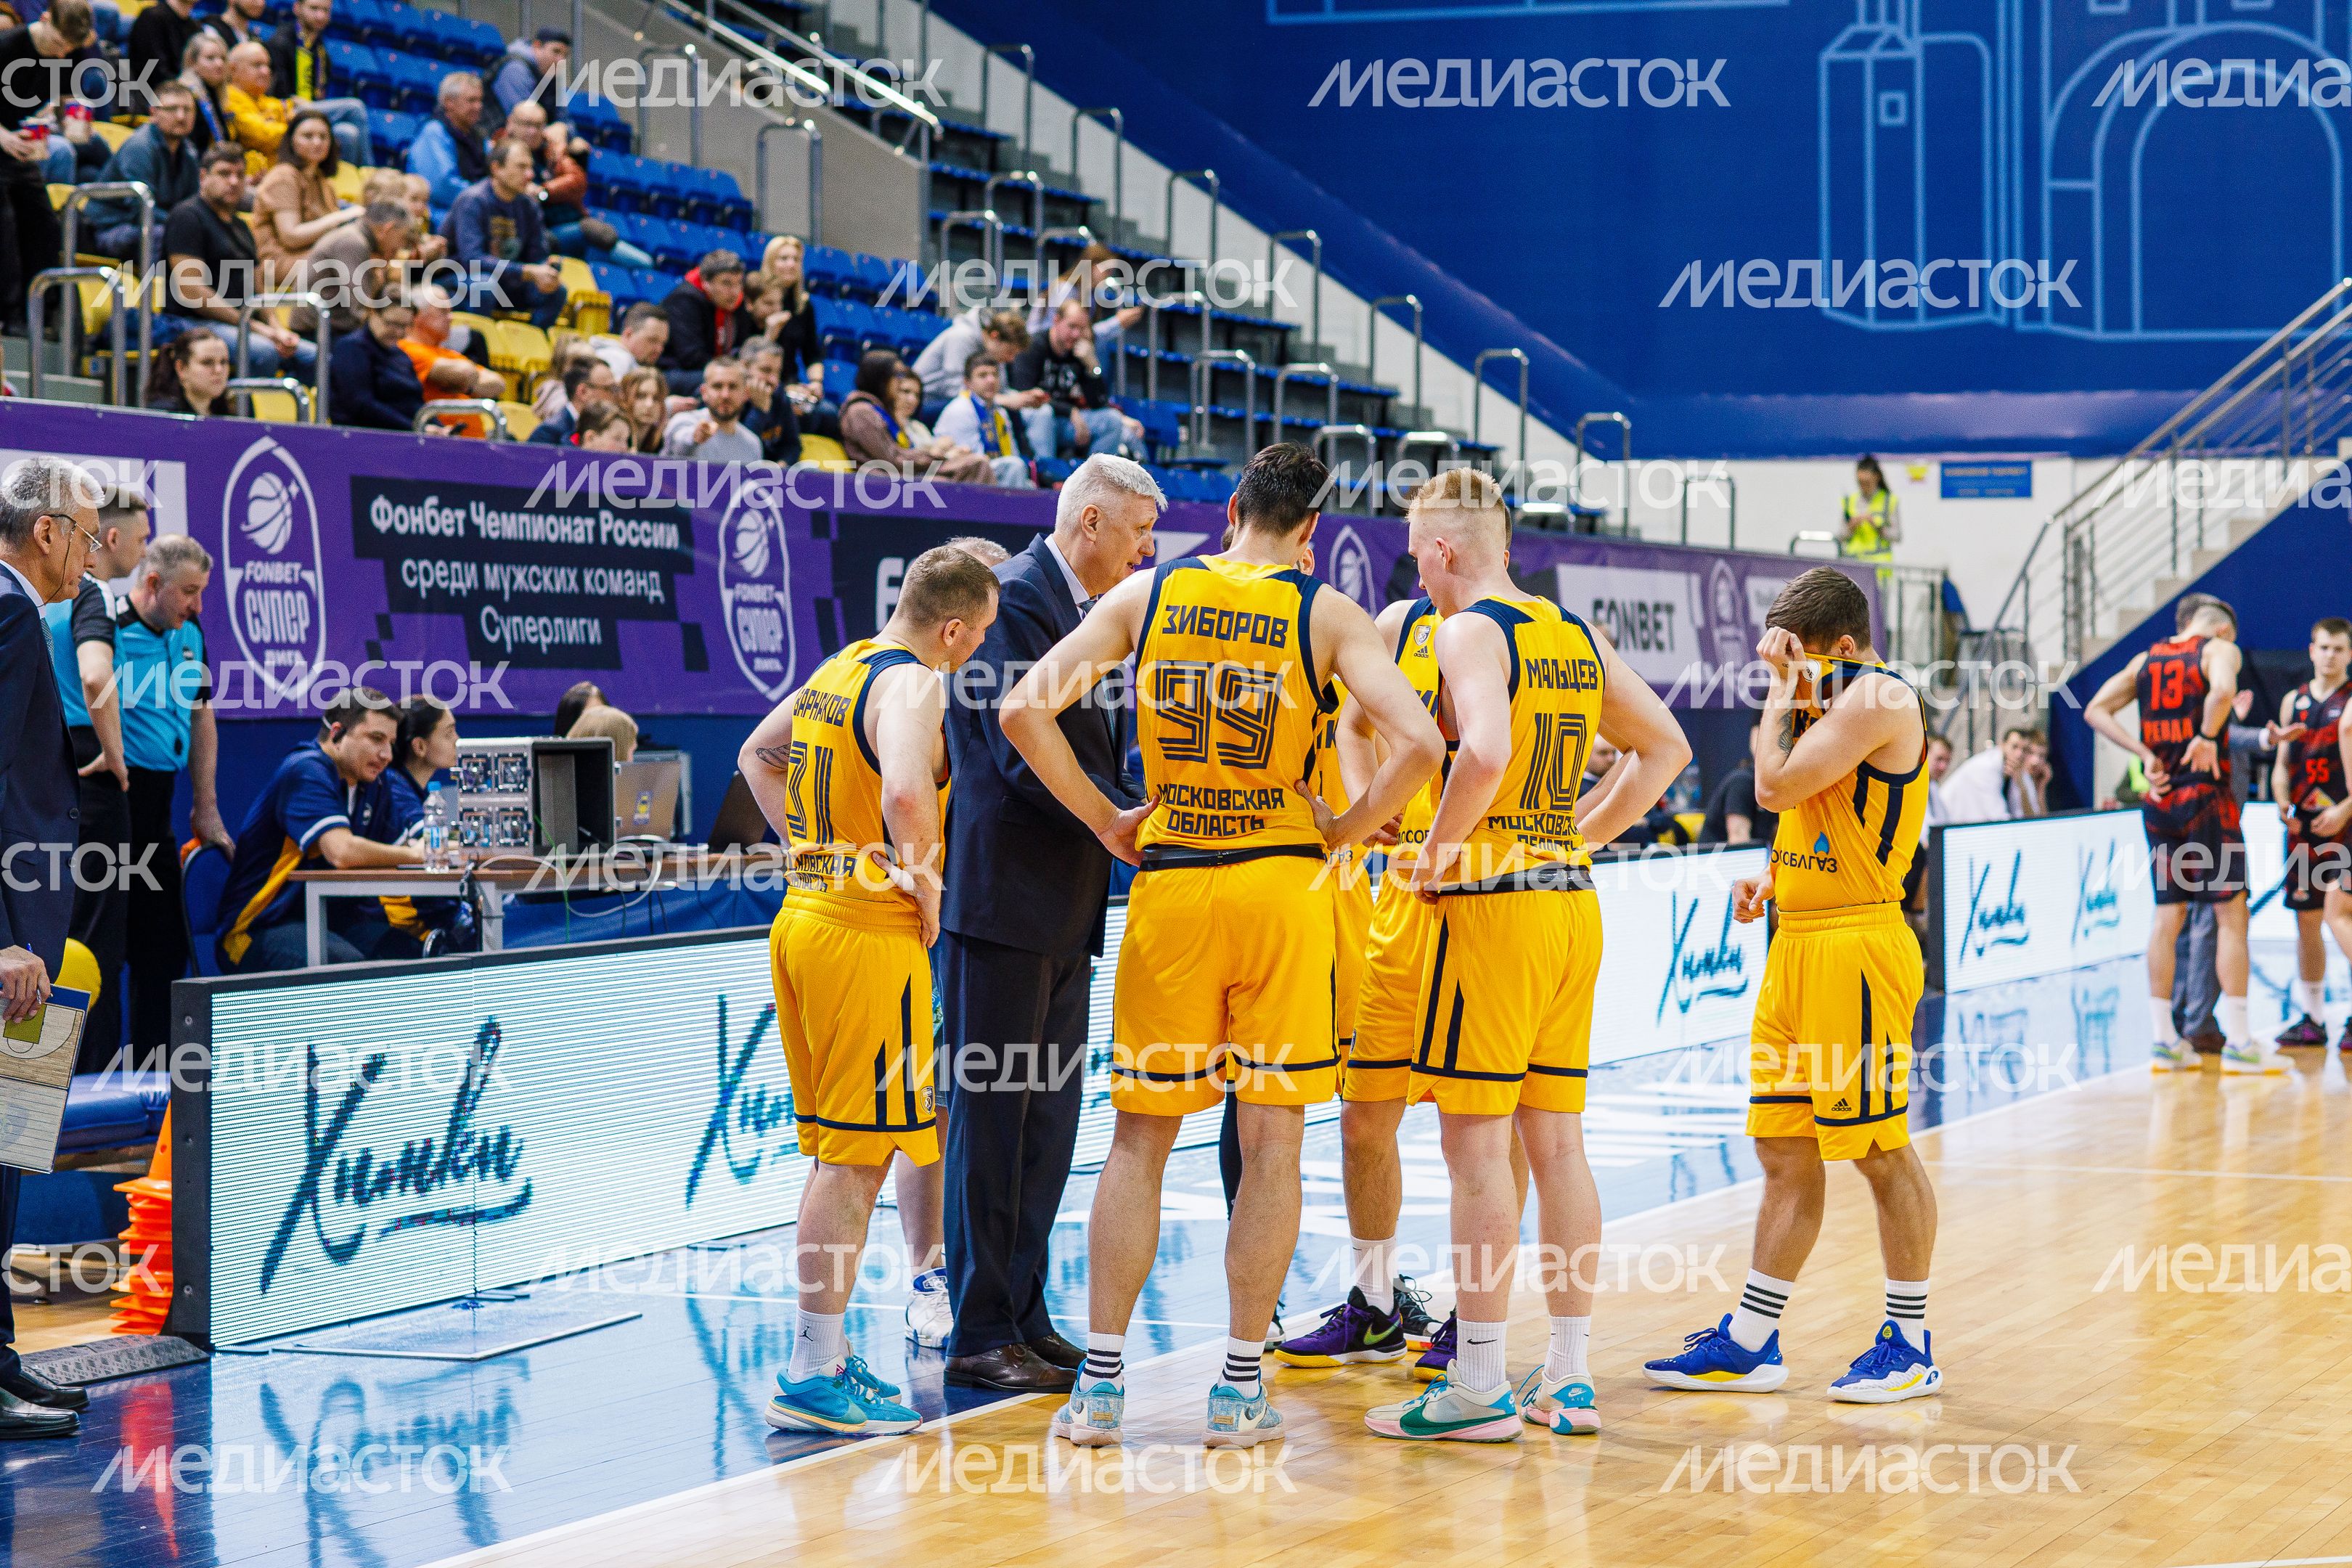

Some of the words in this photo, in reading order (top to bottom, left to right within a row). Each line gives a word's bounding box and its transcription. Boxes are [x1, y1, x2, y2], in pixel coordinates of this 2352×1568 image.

[370, 494, 466, 538] Фонбет
[469, 501, 595, 545] Чемпионат
[599, 510, 679, 550] России
[244, 560, 302, 584] FONBET
[401, 558, 479, 599] среди
[483, 562, 579, 603] мужских
[584, 568, 666, 604] команд
[480, 605, 602, 654] Суперлиги
[1162, 605, 1289, 649] ЗИБОРОВ
[1525, 658, 1598, 693] МАЛЬЦЕВ
[2149, 659, 2185, 710] 13
[1155, 659, 1284, 769] 99
[1519, 713, 1588, 811] 10
[2305, 757, 2329, 784] 55
[786, 740, 834, 846] 31
[1156, 783, 1286, 812] МОСКОВСКАЯ
[1166, 809, 1266, 836] ОБЛАСТЬ
